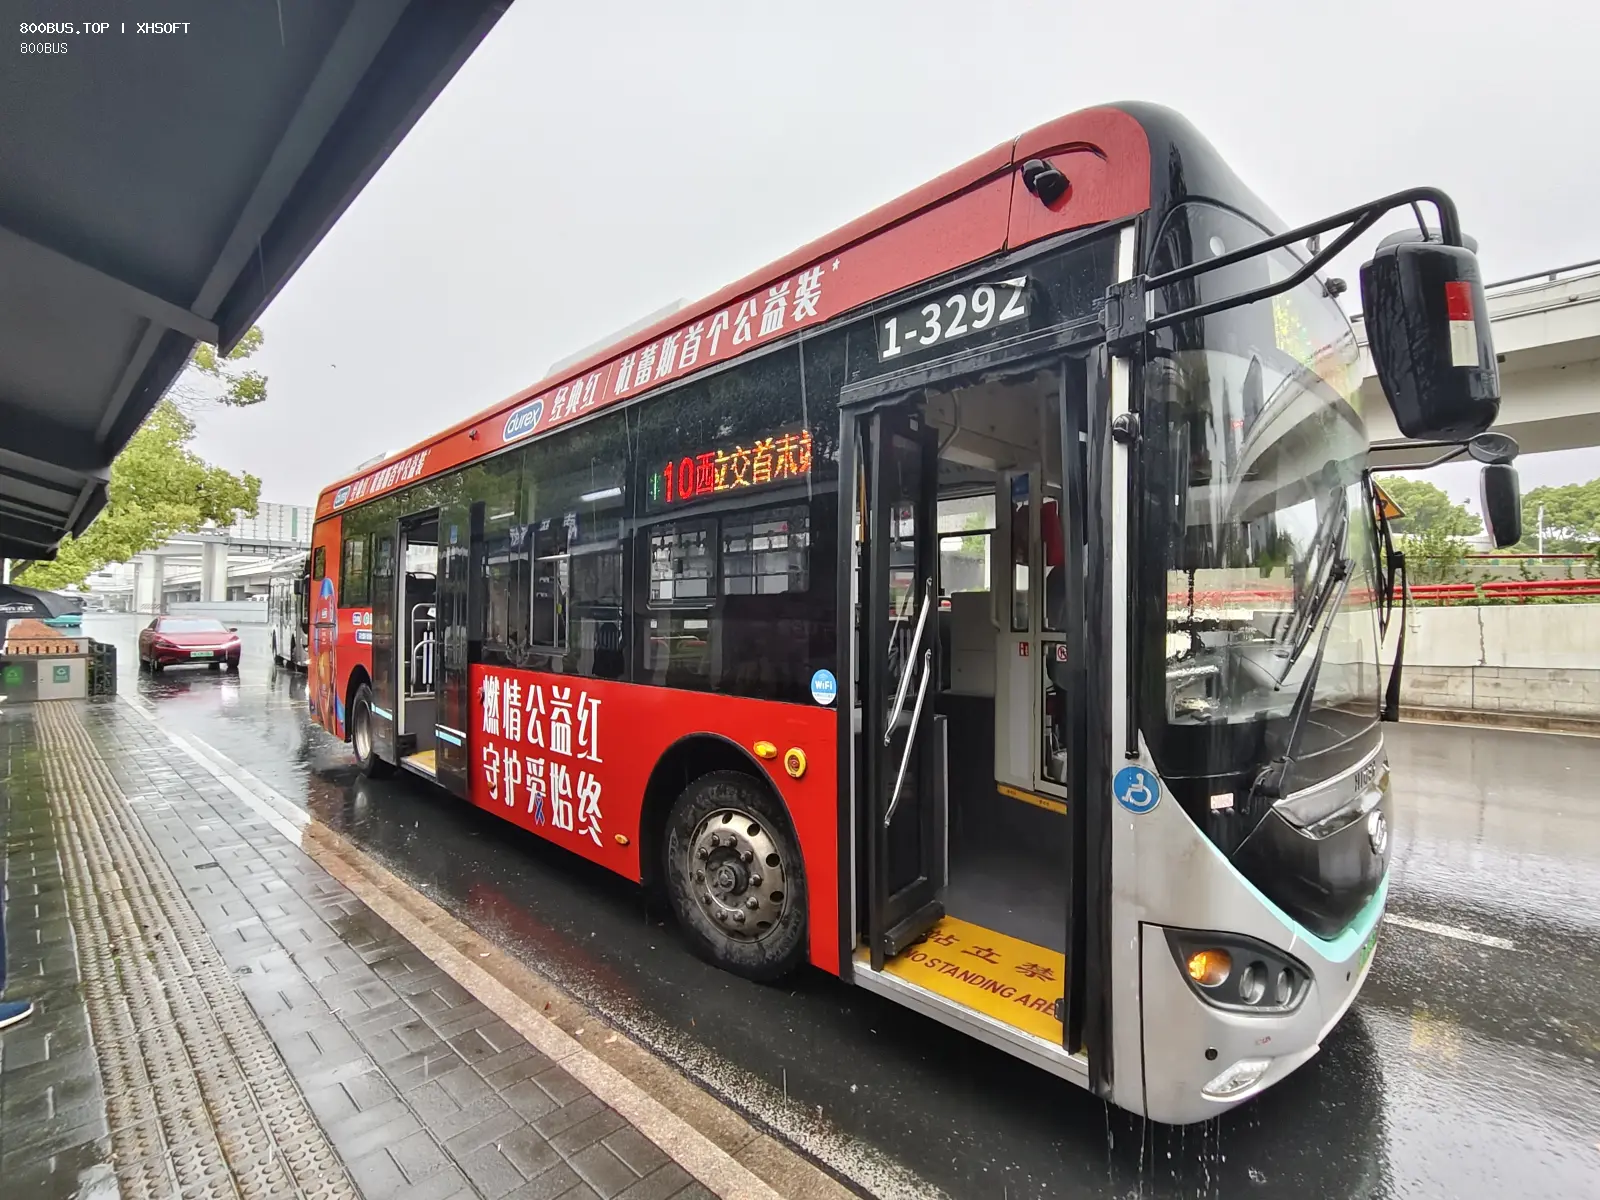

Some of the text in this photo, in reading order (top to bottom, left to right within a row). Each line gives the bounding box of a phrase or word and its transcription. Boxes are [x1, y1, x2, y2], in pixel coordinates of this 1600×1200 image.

[882, 282, 1025, 358] 1-3292
[482, 674, 603, 763] 燃情公益红
[814, 680, 833, 690] WiFi
[482, 742, 603, 848] 守护爱始终
[904, 947, 1057, 1017] NO STANDING ARE
[926, 929, 1058, 982] 站立禁
